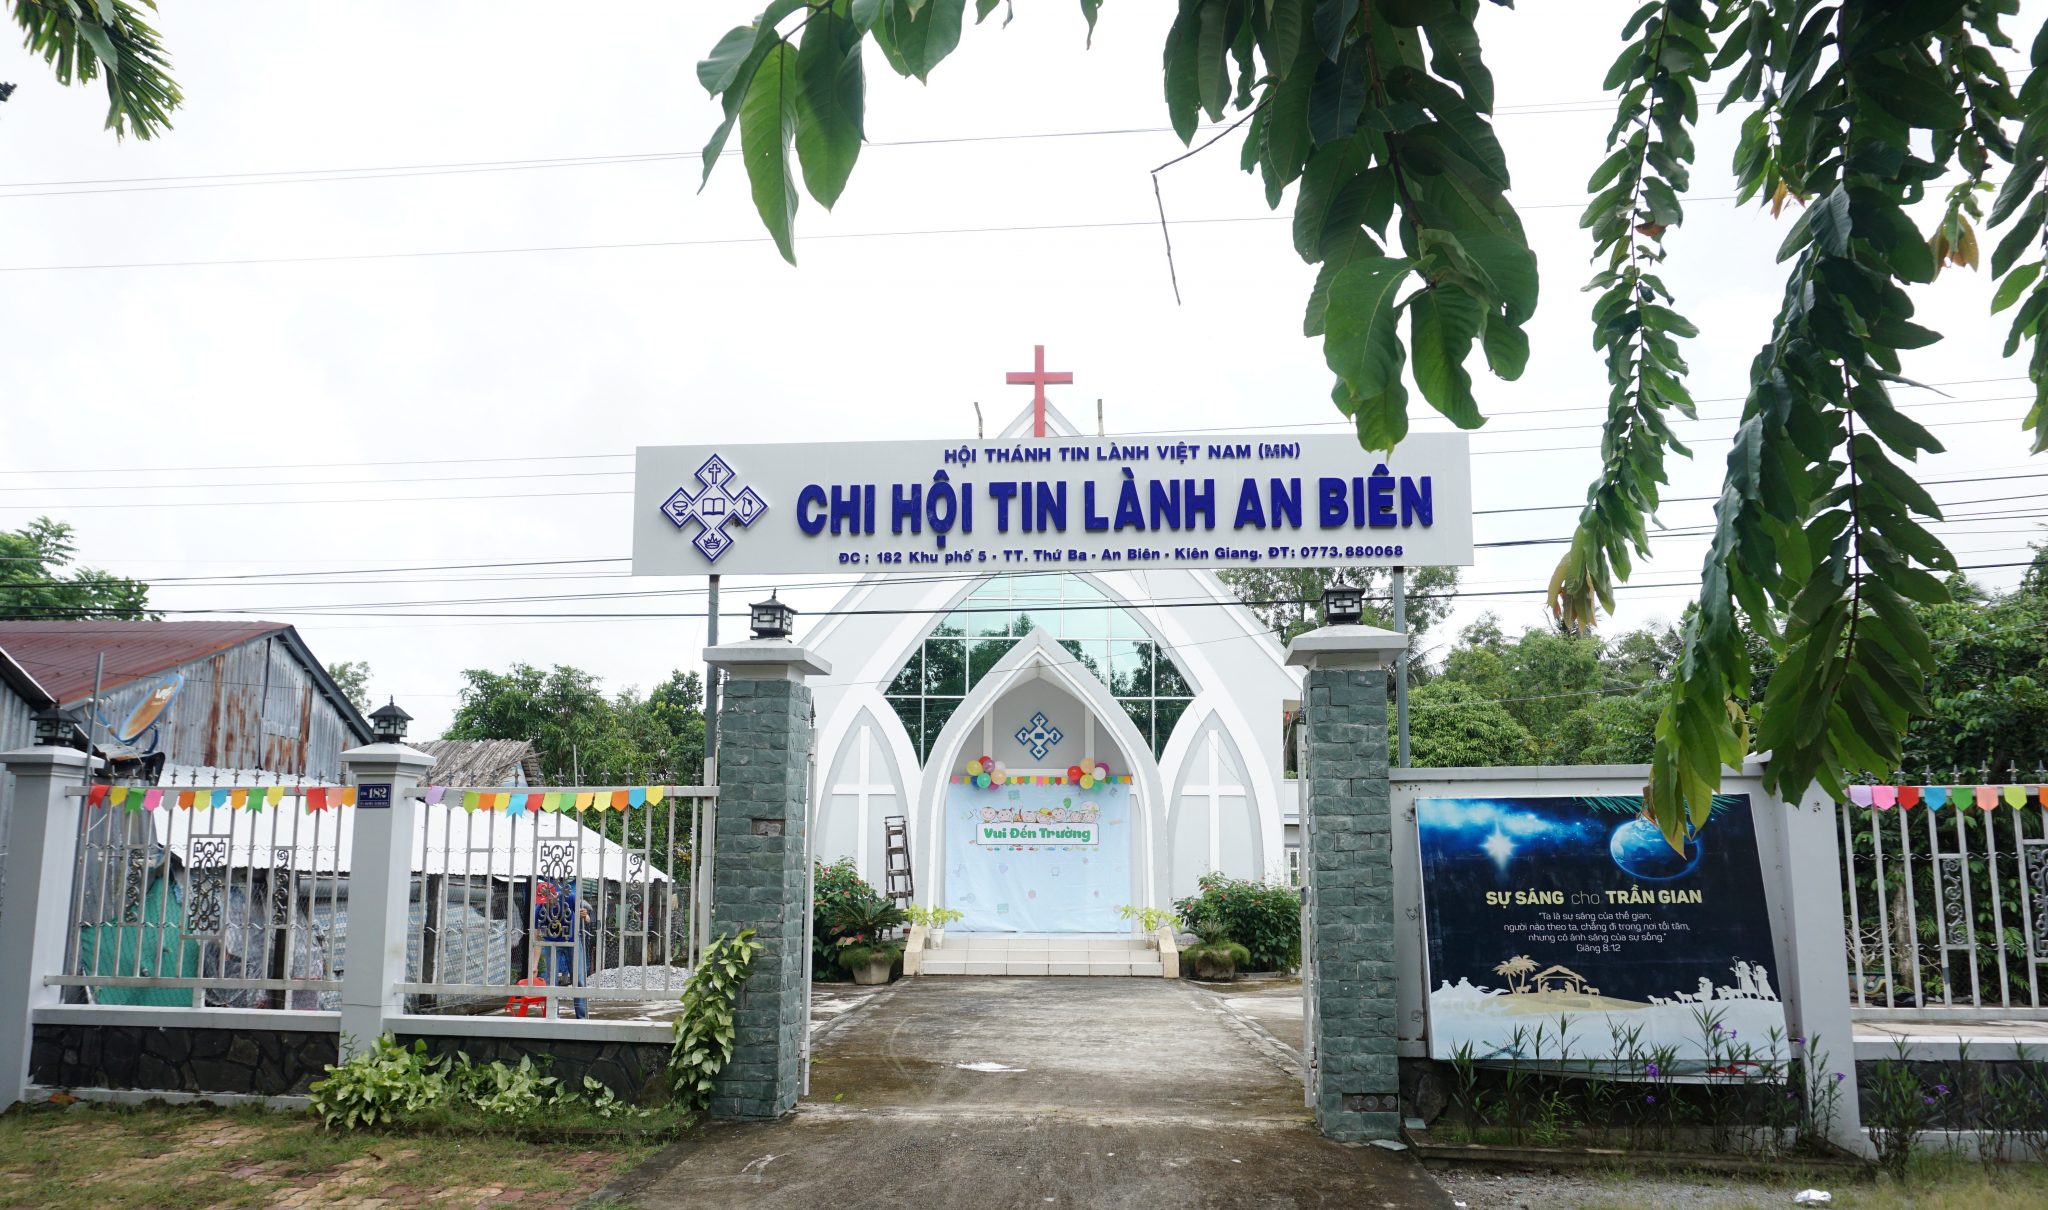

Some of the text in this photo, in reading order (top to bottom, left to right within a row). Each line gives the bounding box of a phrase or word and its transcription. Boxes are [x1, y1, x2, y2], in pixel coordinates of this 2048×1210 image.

[944, 442, 1301, 467] HỘI THÁNH TIN LÀNH VIỆT NAM (MN)
[796, 463, 1433, 549] CHI HỘI TIN LÀNH AN BIÊN
[877, 552, 902, 564] 182
[909, 551, 938, 563] Khu
[945, 549, 974, 565] phố
[977, 551, 987, 562] 5
[1004, 550, 1028, 562] TT.
[1033, 549, 1062, 561] Thứ
[1068, 549, 1087, 561] Ba
[1101, 549, 1122, 561] An
[1127, 548, 1160, 560] Biên
[1175, 547, 1208, 560] Kiên
[1268, 546, 1295, 558] ĐT:
[1300, 545, 1403, 558] 0773.880068
[369, 788, 387, 798] 182
[984, 825, 1090, 842] Vui Đến Trường
[1486, 884, 1702, 908] SỰ SÁNG cho TRẦN GIAN
[1553, 912, 1560, 920] là
[1576, 912, 1595, 921] sáng
[1598, 912, 1613, 920] của
[1615, 911, 1629, 920] thế
[1504, 923, 1527, 932] người
[1580, 921, 1607, 933] chẳng
[1619, 924, 1641, 932] trong
[1659, 921, 1669, 930] tối
[1529, 934, 1555, 943] nhưng
[1588, 933, 1609, 943] sáng
[1611, 933, 1626, 941] của
[1576, 943, 1601, 954] Giăng
